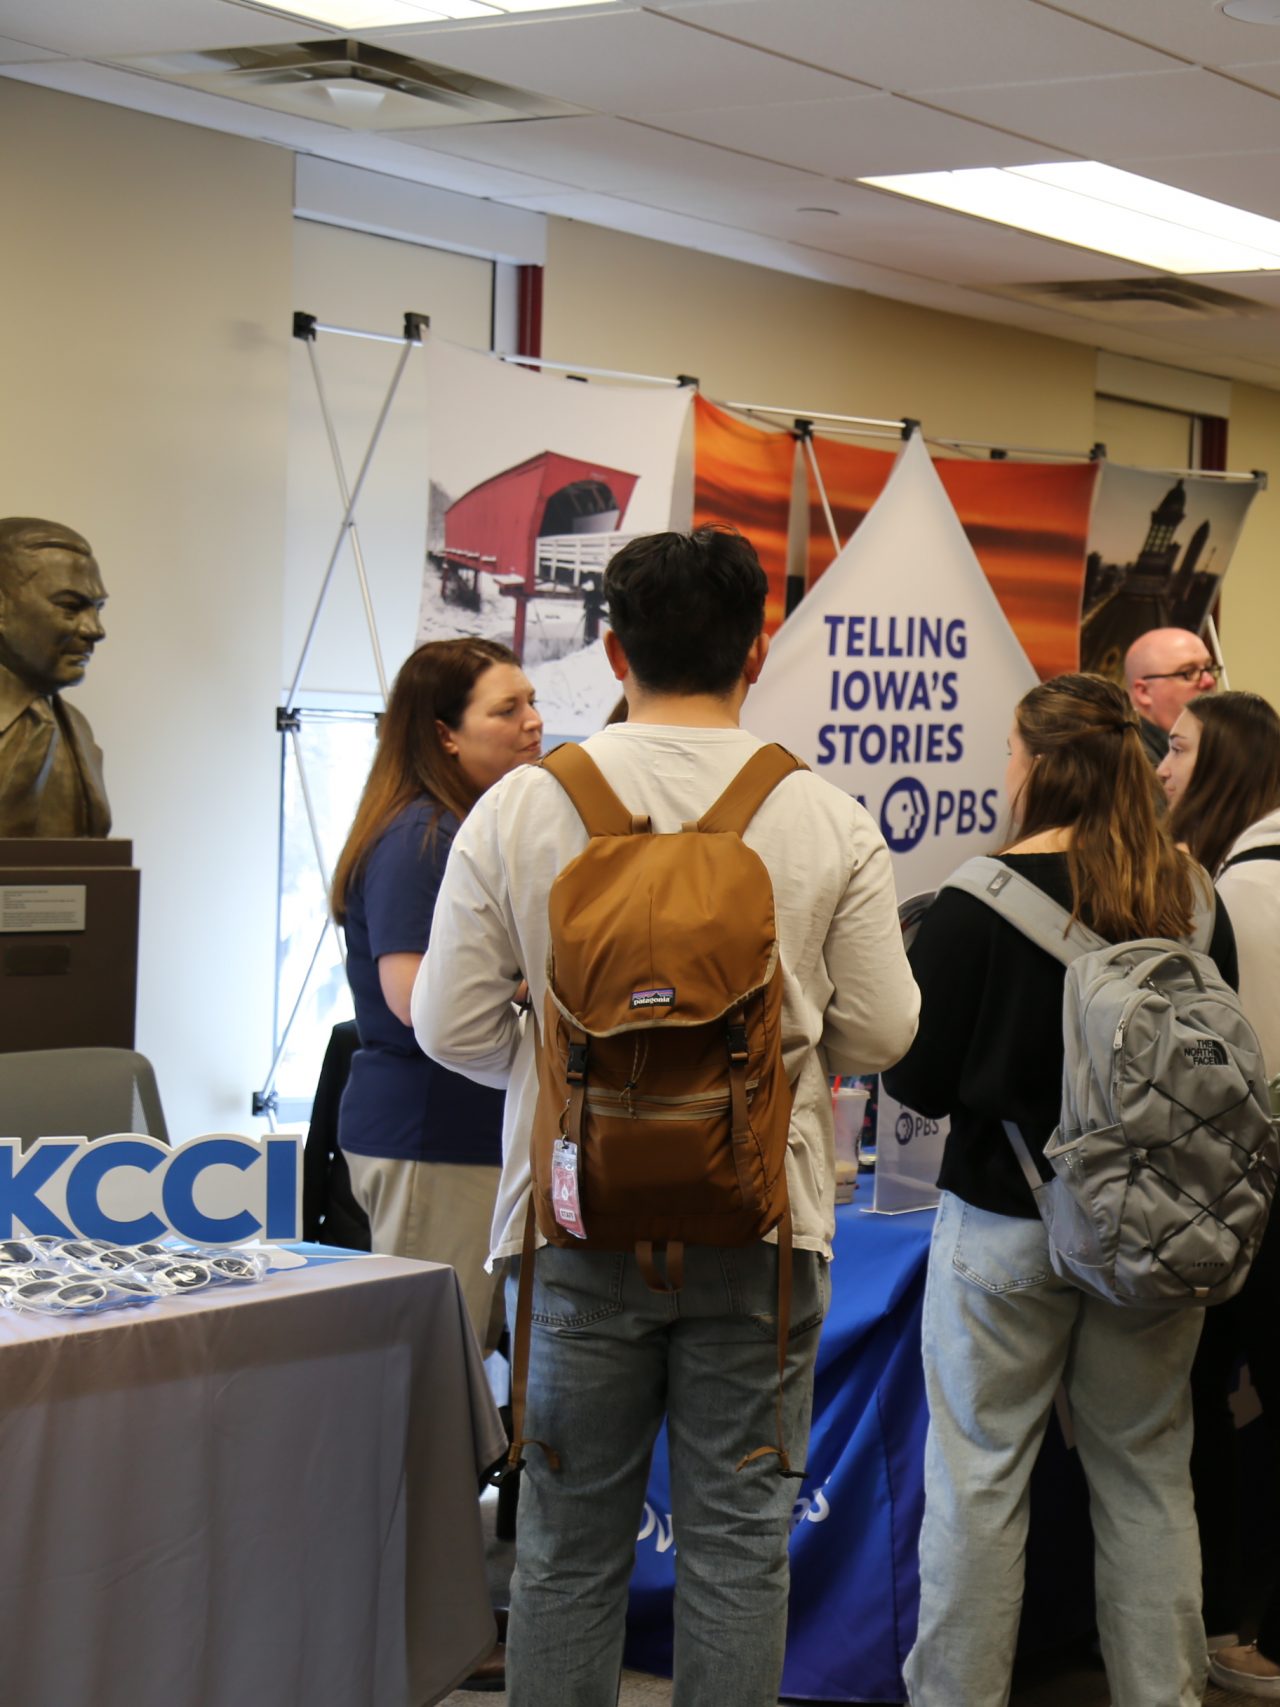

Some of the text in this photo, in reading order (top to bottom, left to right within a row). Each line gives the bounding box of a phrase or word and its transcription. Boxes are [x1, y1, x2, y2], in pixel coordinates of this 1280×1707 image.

[824, 615, 967, 659] TELLING
[830, 670, 958, 711] IOWA'S
[817, 724, 964, 765] STORIES
[934, 789, 998, 837] PBS
[633, 996, 671, 1006] patagonia
[1184, 1048, 1214, 1057] NORTH
[1197, 1039, 1213, 1048] THE
[1193, 1056, 1215, 1066] FACE
[915, 1116, 940, 1138] PBS
[0, 1139, 298, 1245] KCCI
